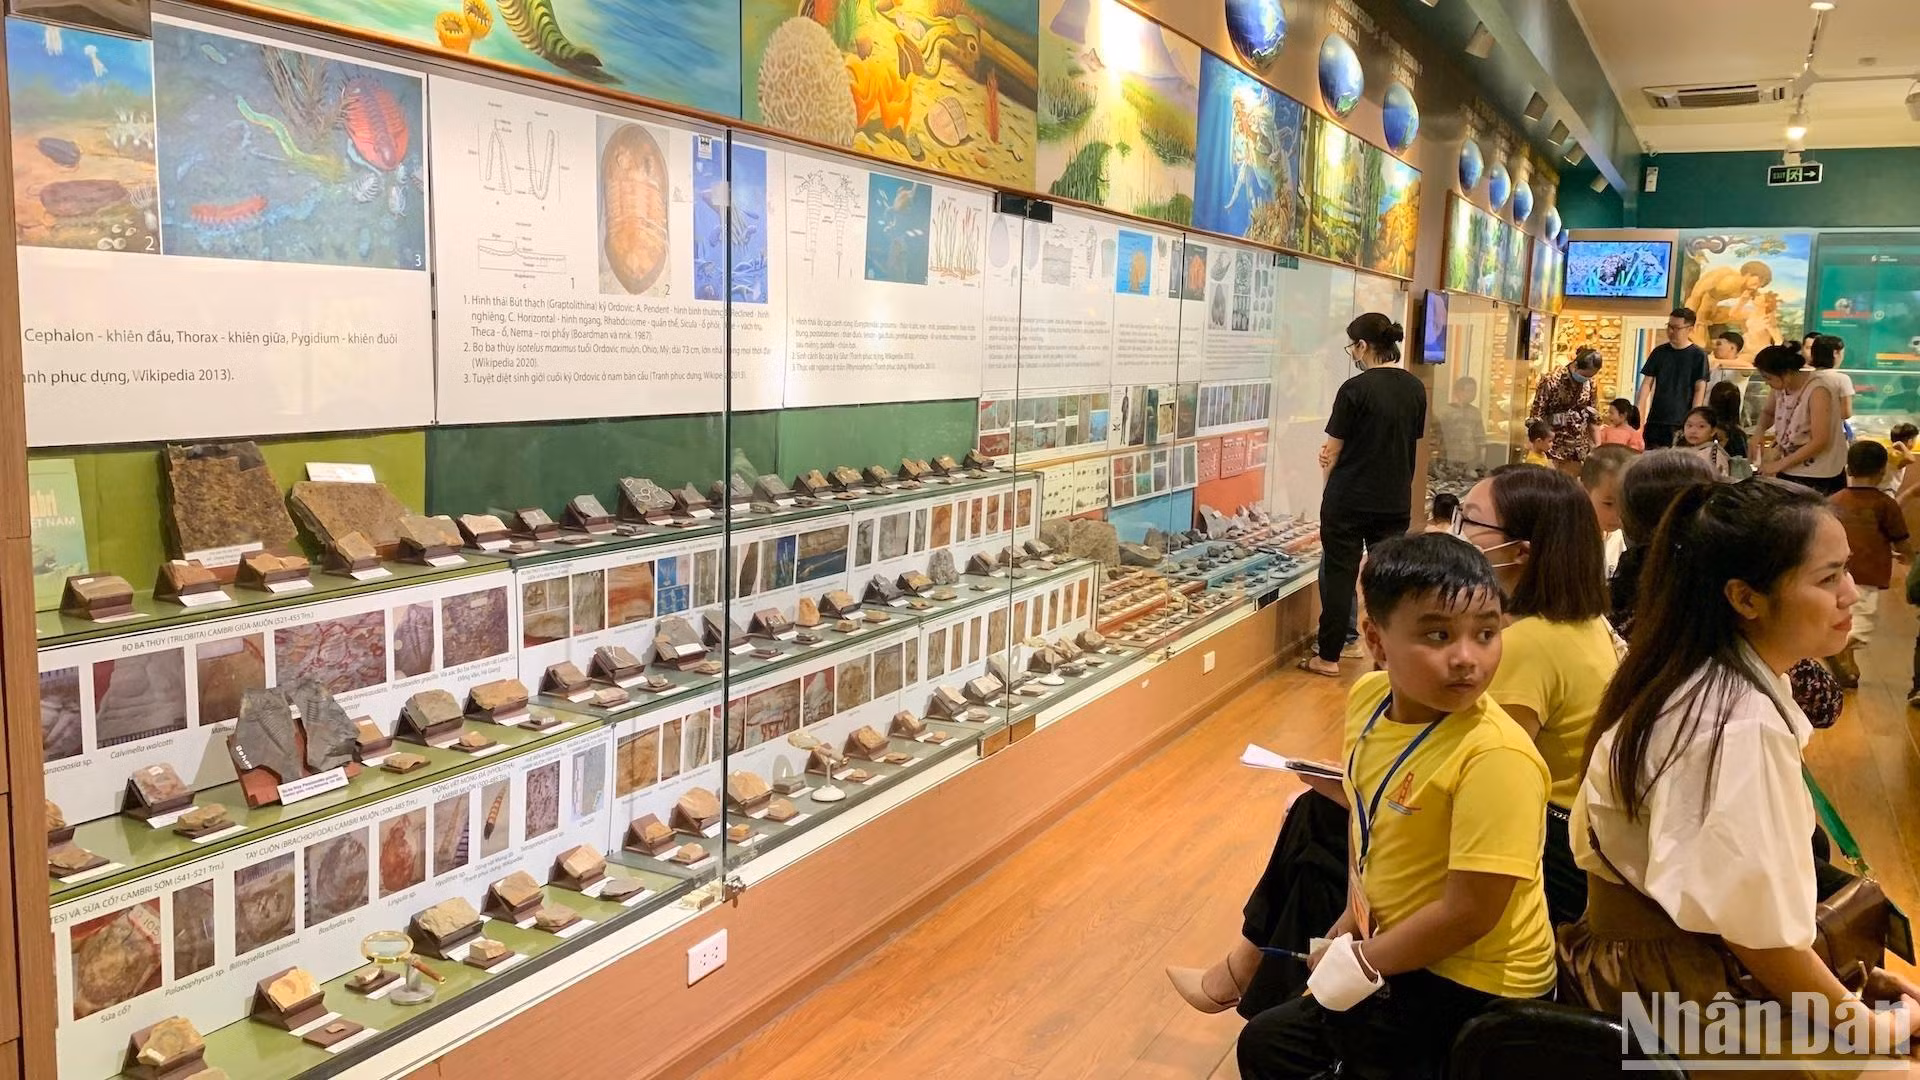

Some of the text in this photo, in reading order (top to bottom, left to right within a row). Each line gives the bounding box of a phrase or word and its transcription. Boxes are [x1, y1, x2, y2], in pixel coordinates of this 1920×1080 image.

[1773, 172, 1786, 180] EXIT
[144, 236, 155, 252] 2
[415, 254, 422, 268] 3
[665, 284, 671, 296] 2
[472, 296, 491, 306] Hình
[644, 304, 670, 314] Pendent
[518, 313, 556, 323] Horizontal
[24, 328, 94, 345] Cephalon
[106, 330, 143, 343] khiên
[176, 330, 218, 343] Thorax
[228, 331, 260, 344] khiên
[292, 332, 340, 347] Pygidium
[348, 333, 374, 344] khiên
[471, 326, 496, 337] Theca
[486, 342, 495, 352] ba
[472, 358, 514, 370] (Wikipedia
[91, 370, 130, 386] dựng,
[132, 368, 195, 384] Wikipedia
[199, 368, 235, 381] 2013).
[135, 642, 145, 650] BA
[168, 631, 207, 644] (TRILOBITA)
[208, 626, 234, 638] CAMBRI
[110, 745, 145, 760] Calvinella
[246, 852, 258, 860] TAY
[281, 826, 334, 848] (BRACHIOPODA)
[334, 817, 359, 830] CAMBRI
[68, 908, 81, 919] VÀ
[120, 886, 153, 902] CAMBRI
[165, 974, 214, 998] Palaeophycus
